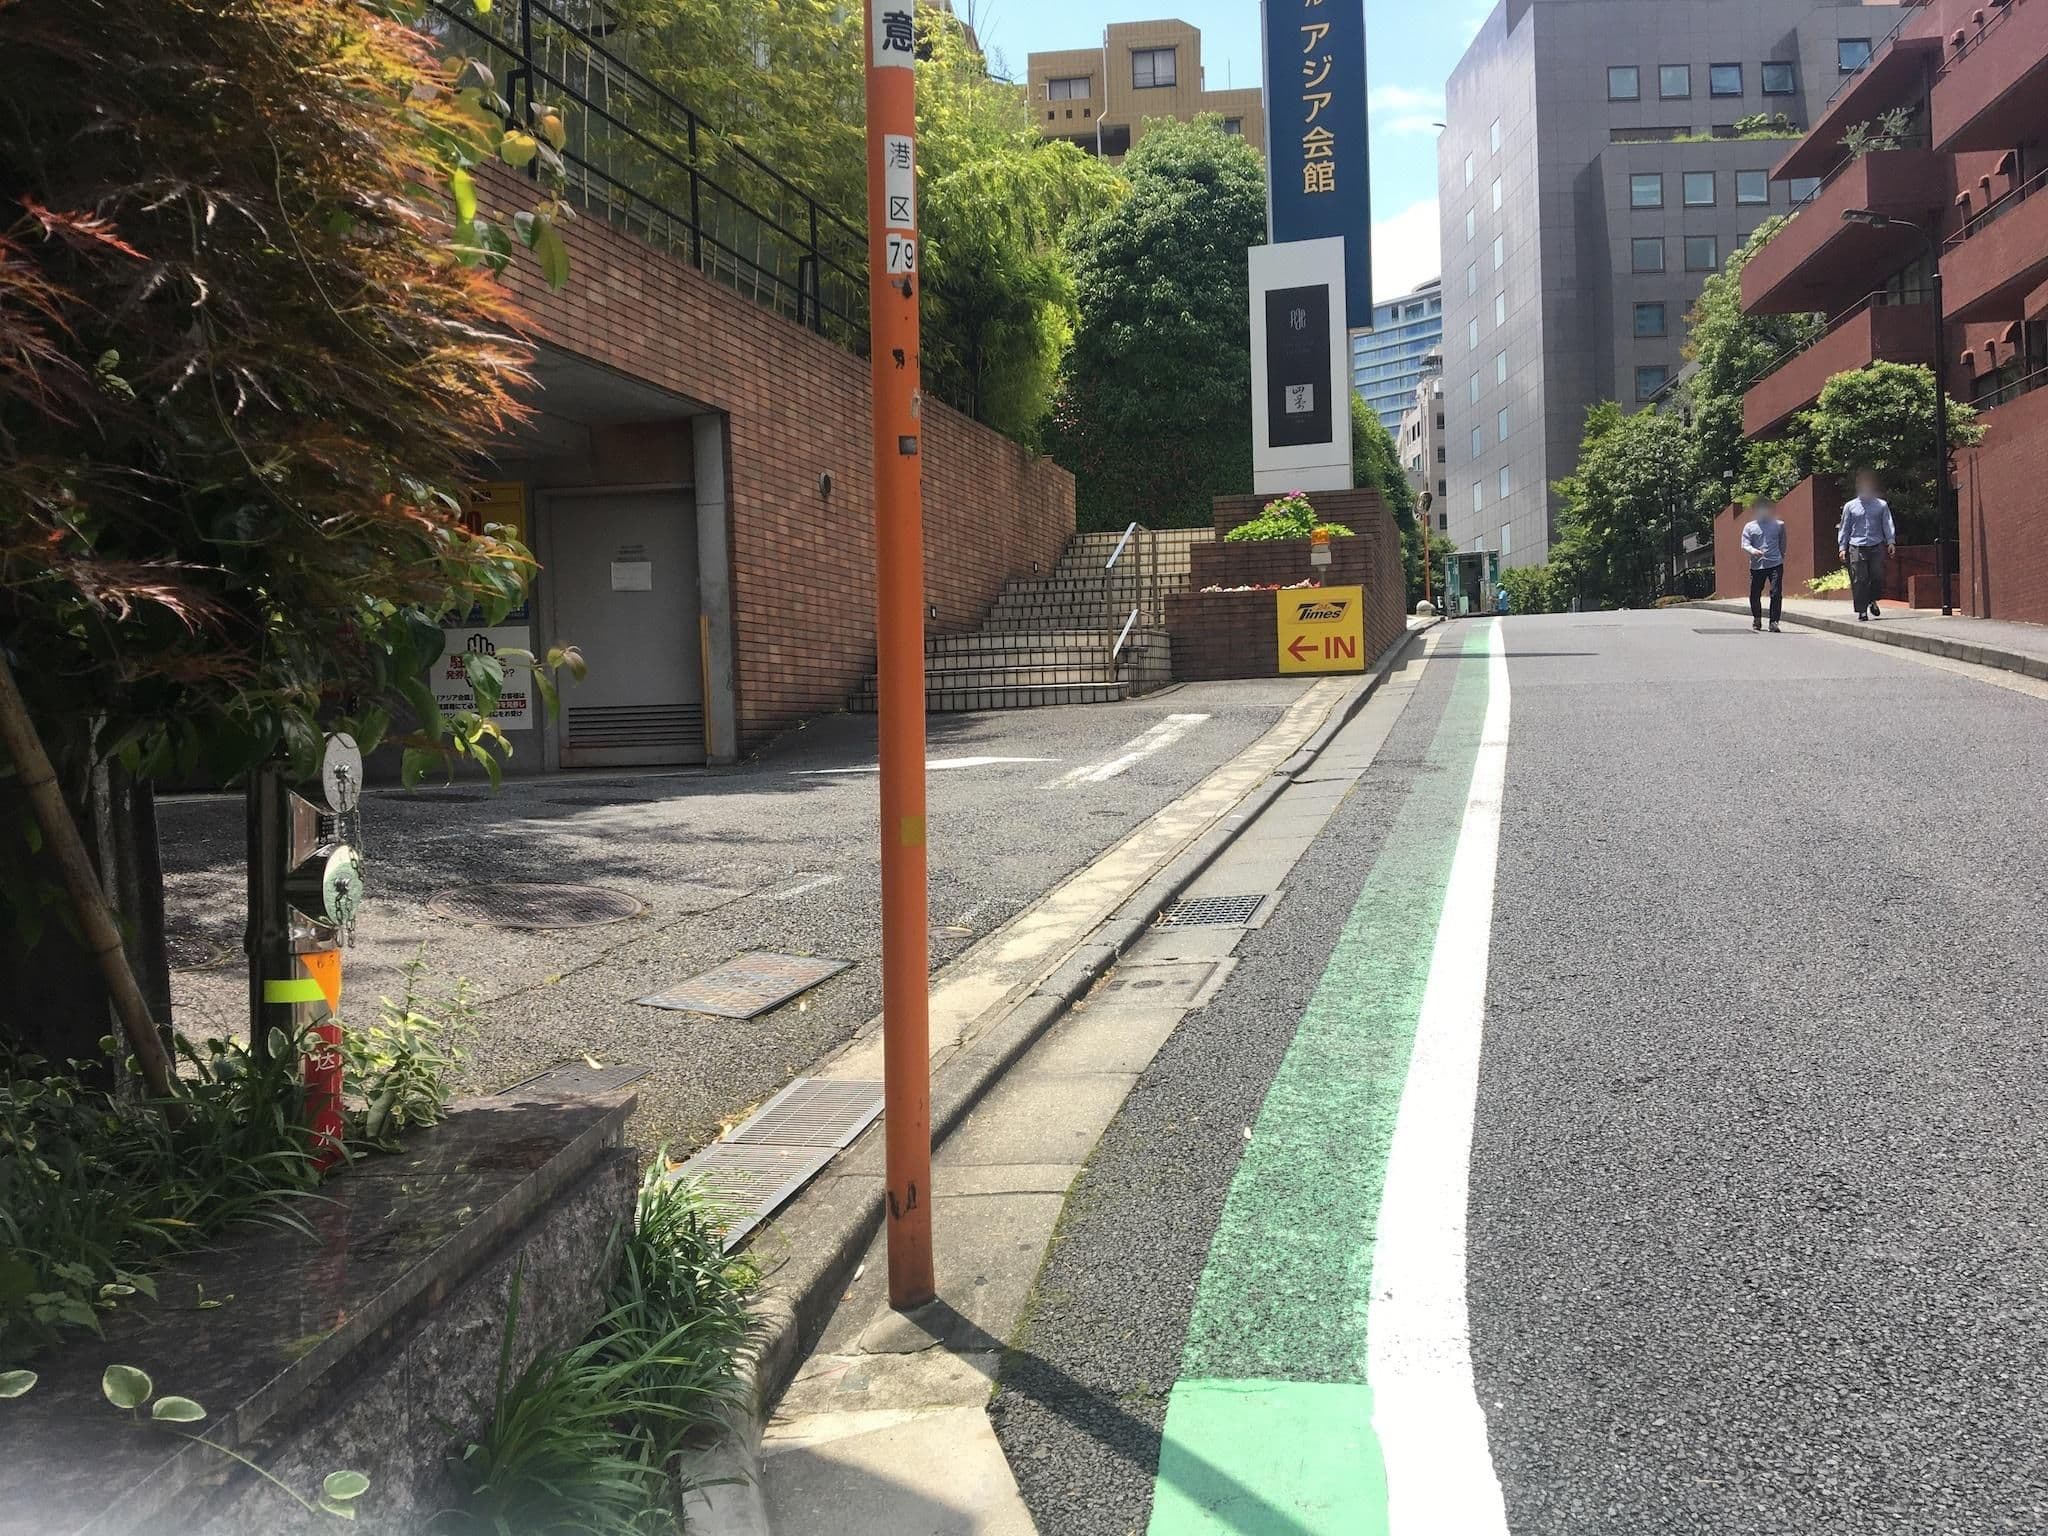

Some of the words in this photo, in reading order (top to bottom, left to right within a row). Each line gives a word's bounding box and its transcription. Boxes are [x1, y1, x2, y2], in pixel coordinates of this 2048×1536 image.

[1300, 22, 1336, 194] アジア会館
[889, 142, 910, 222] 港区
[889, 241, 914, 269] 79
[1297, 604, 1342, 621] Times
[1325, 636, 1356, 659] IN
